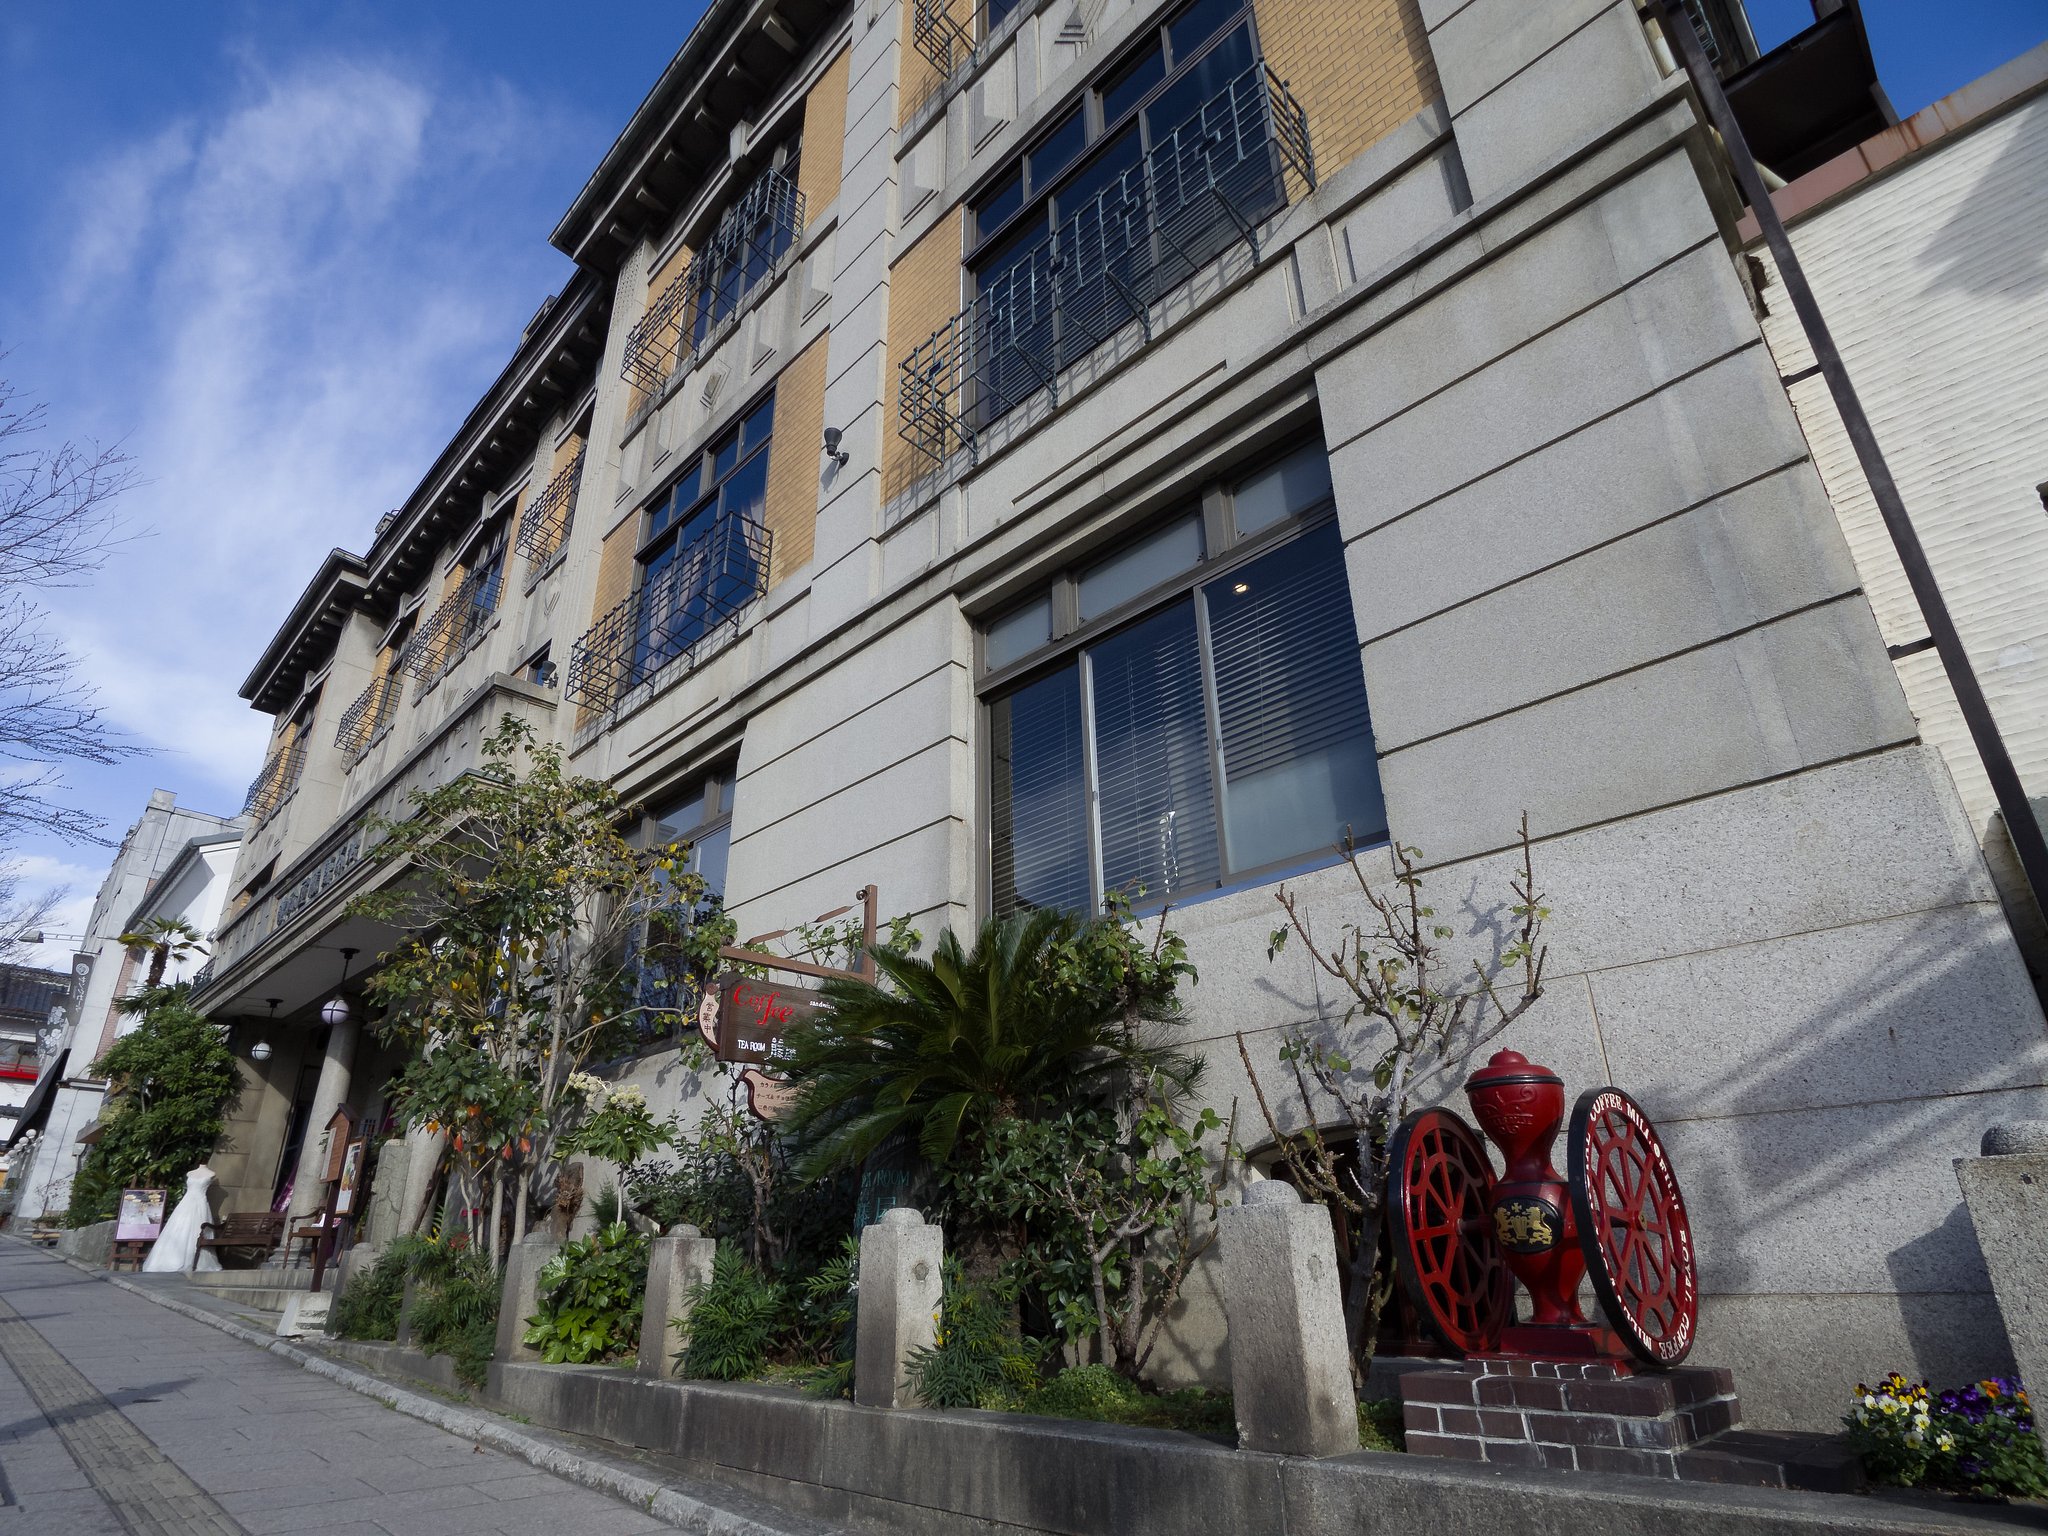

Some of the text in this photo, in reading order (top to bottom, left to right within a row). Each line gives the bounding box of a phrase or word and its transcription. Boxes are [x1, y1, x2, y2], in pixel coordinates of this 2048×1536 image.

[703, 1001, 714, 1033] 営業中
[733, 984, 793, 1025] Coffee
[737, 1039, 766, 1052] TEA ROOM
[1590, 1092, 1622, 1121] COFFEE
[1626, 1102, 1652, 1144] MILL
[1679, 1230, 1693, 1302] ROYAL
[1659, 1312, 1690, 1360] COFFEE
